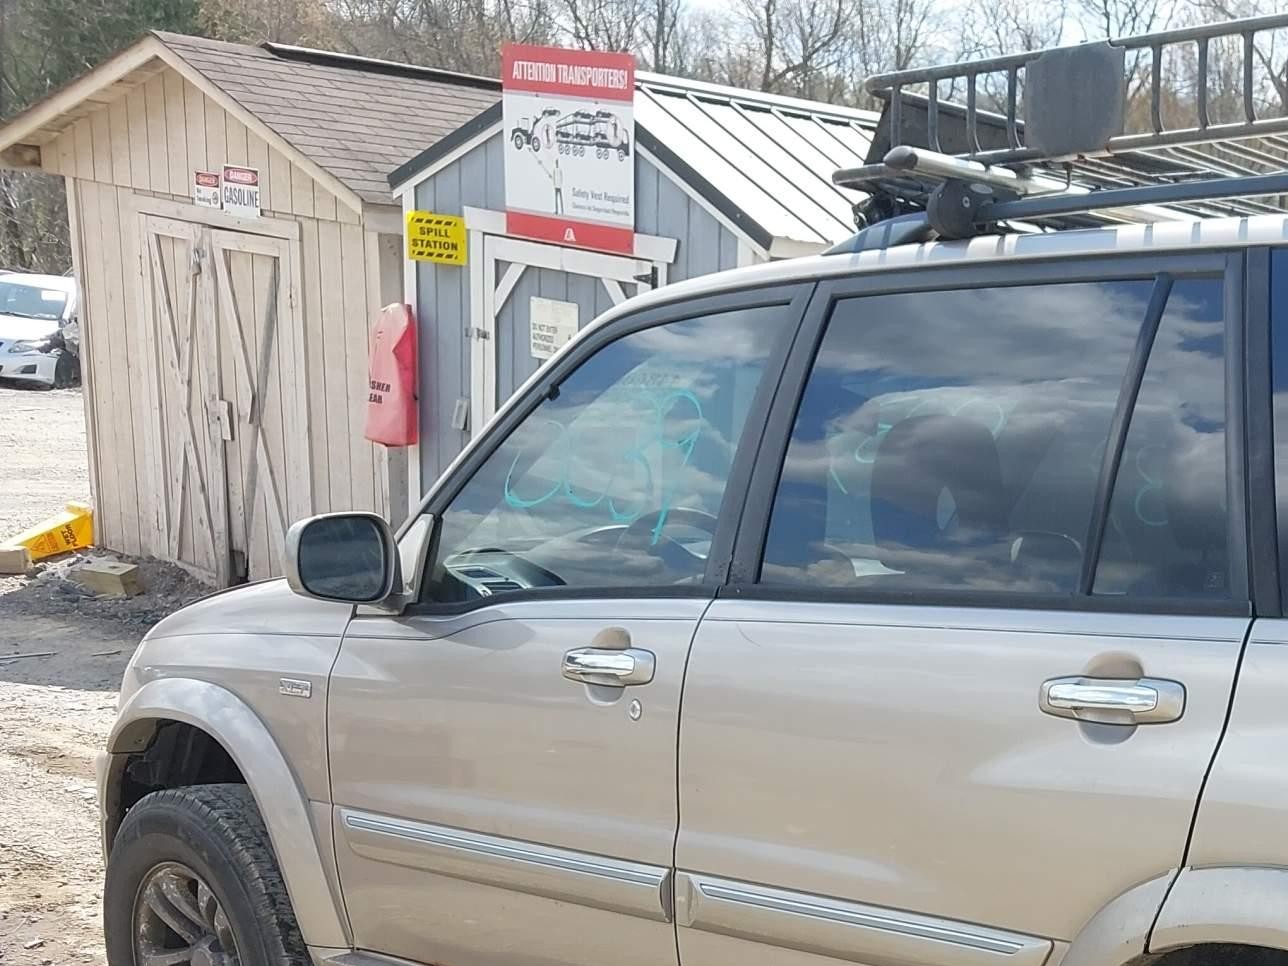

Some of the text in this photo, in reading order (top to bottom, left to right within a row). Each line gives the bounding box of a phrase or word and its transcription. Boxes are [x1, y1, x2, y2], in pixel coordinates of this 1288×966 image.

[512, 60, 628, 90] ATTENTION TRANSPORTERS!
[224, 186, 259, 208] GASOLINE
[419, 226, 451, 238] SPILL
[411, 238, 459, 251] STATION
